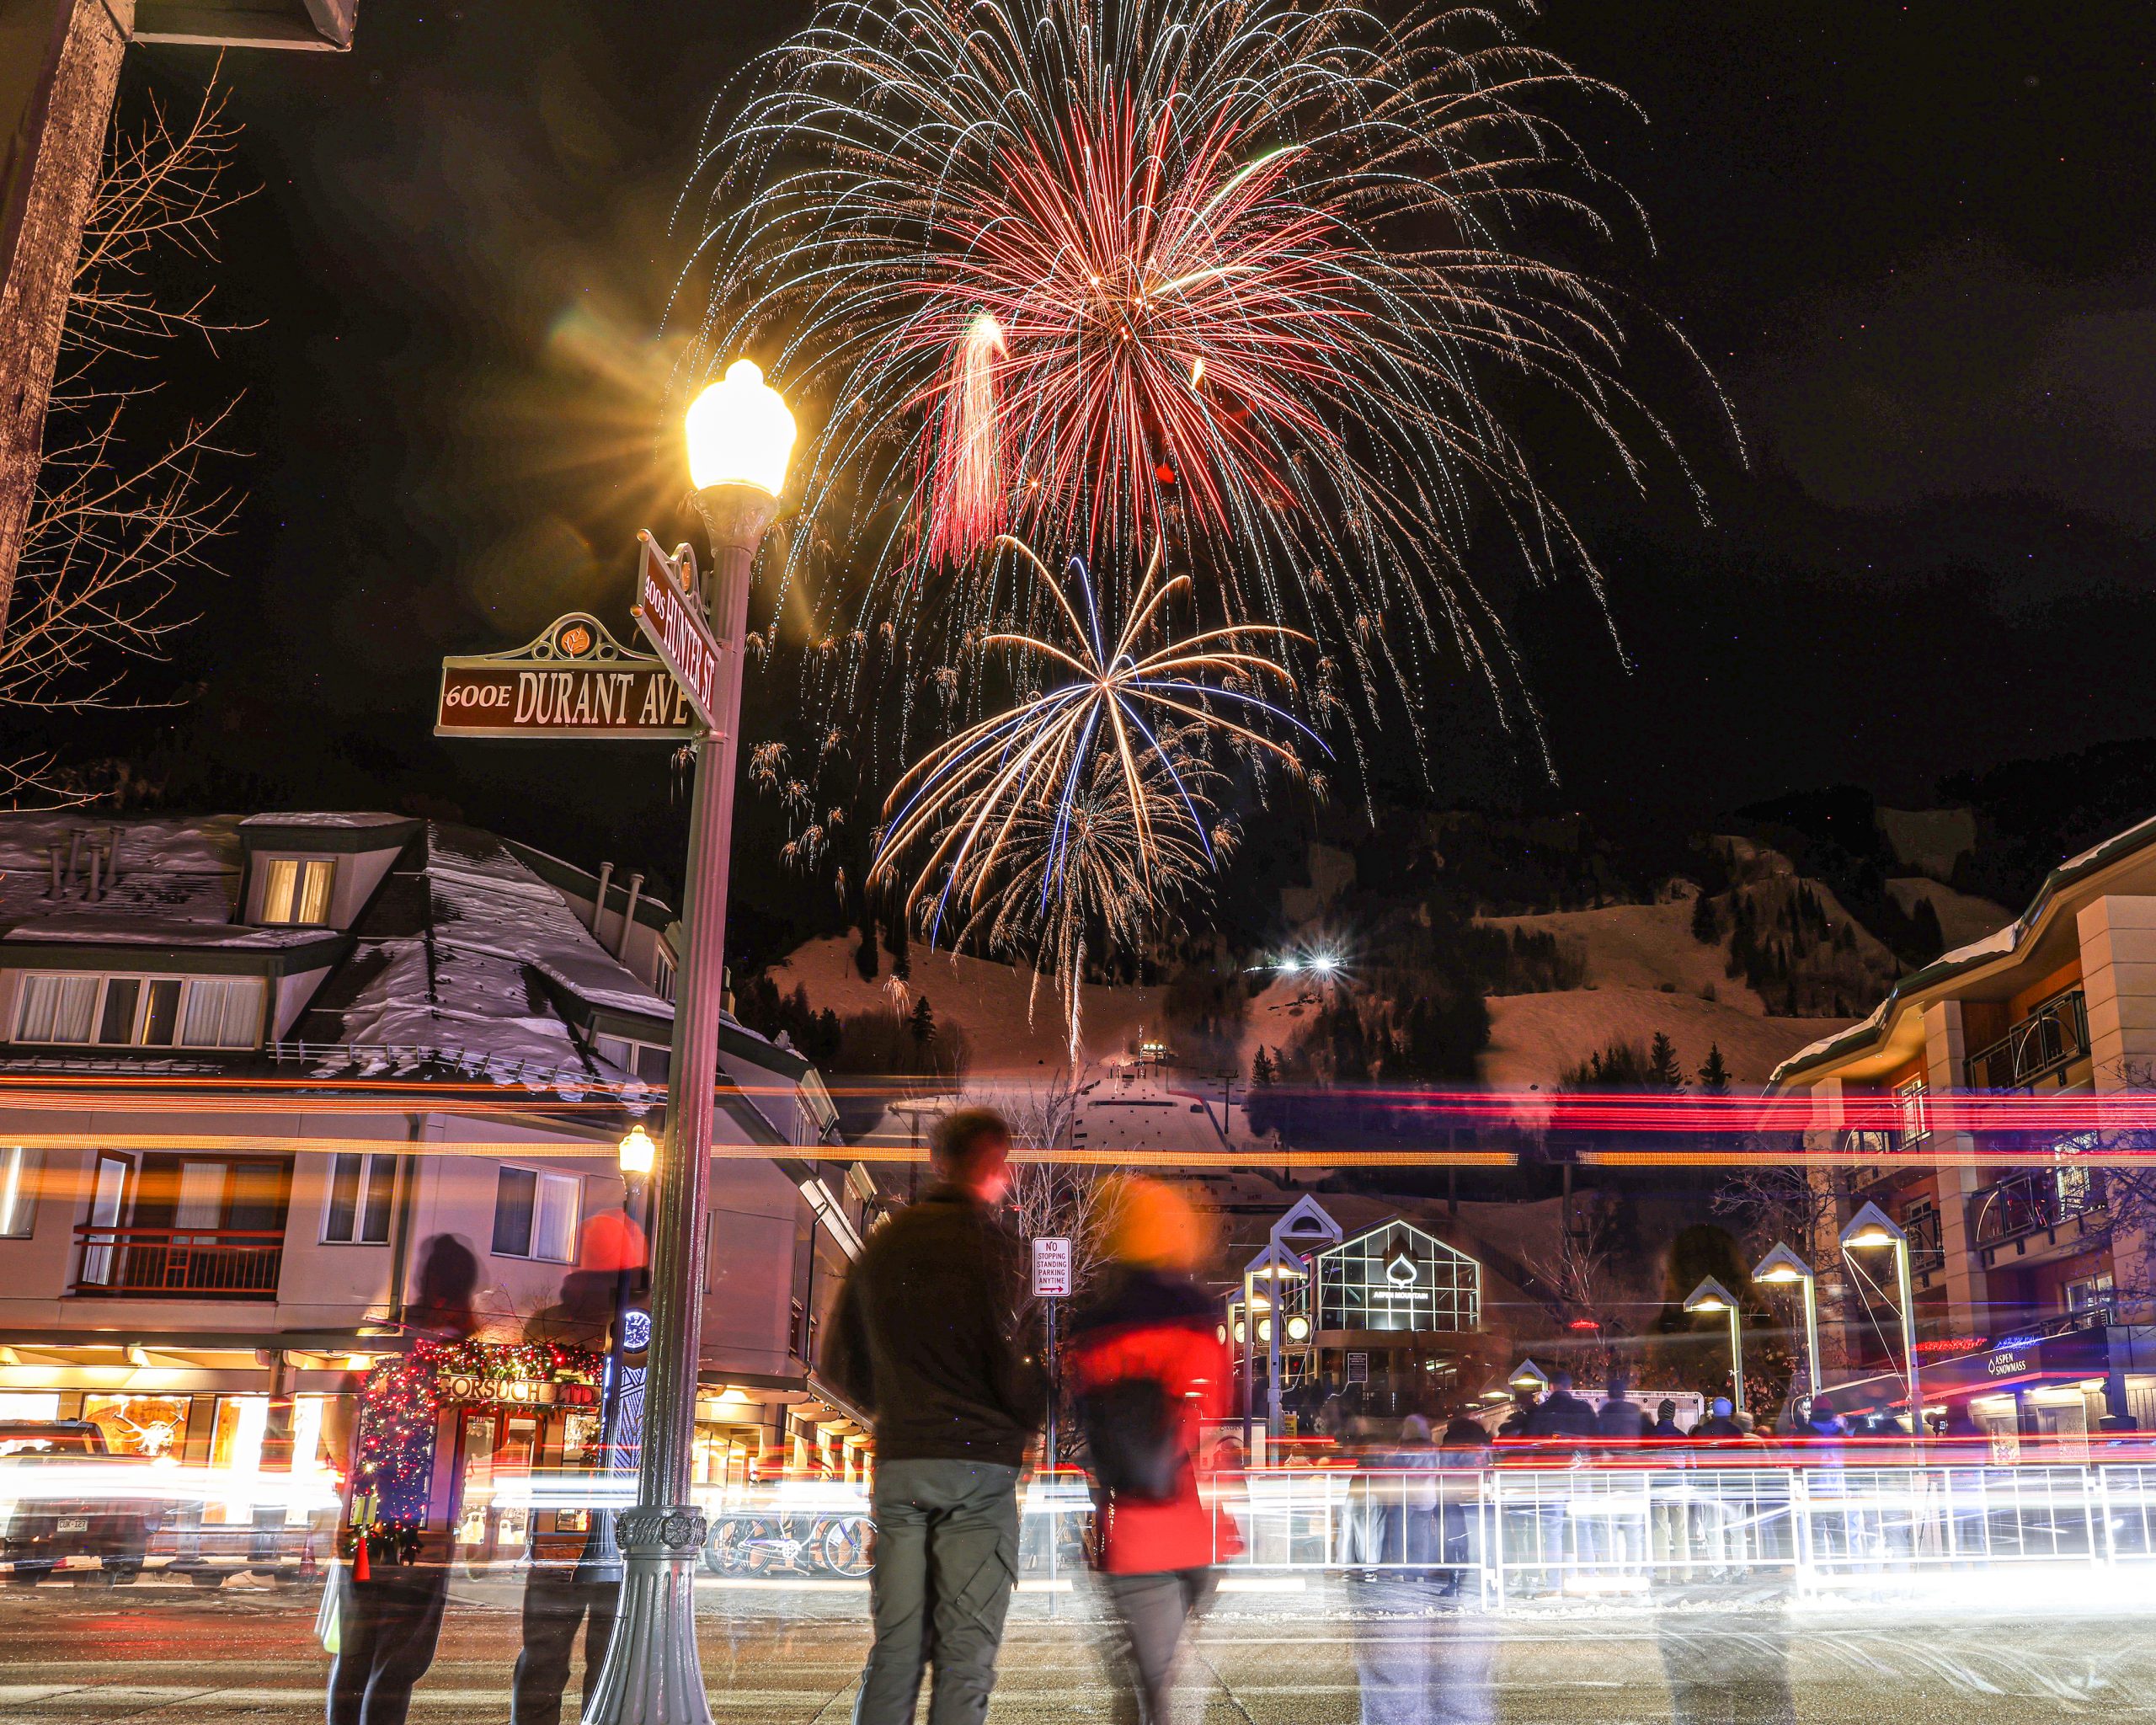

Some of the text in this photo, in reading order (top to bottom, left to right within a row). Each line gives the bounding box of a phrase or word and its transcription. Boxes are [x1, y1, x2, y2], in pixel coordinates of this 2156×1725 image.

[645, 574, 715, 709] 400S HUNTER ST
[446, 685, 512, 708] 600E
[514, 671, 634, 725] DURANT
[1045, 1242, 1058, 1251] NO
[1995, 1353, 2014, 1365] ASPEN
[1996, 1359, 2026, 1375] SNOWMASS
[439, 1375, 541, 1402] GORSUCH
